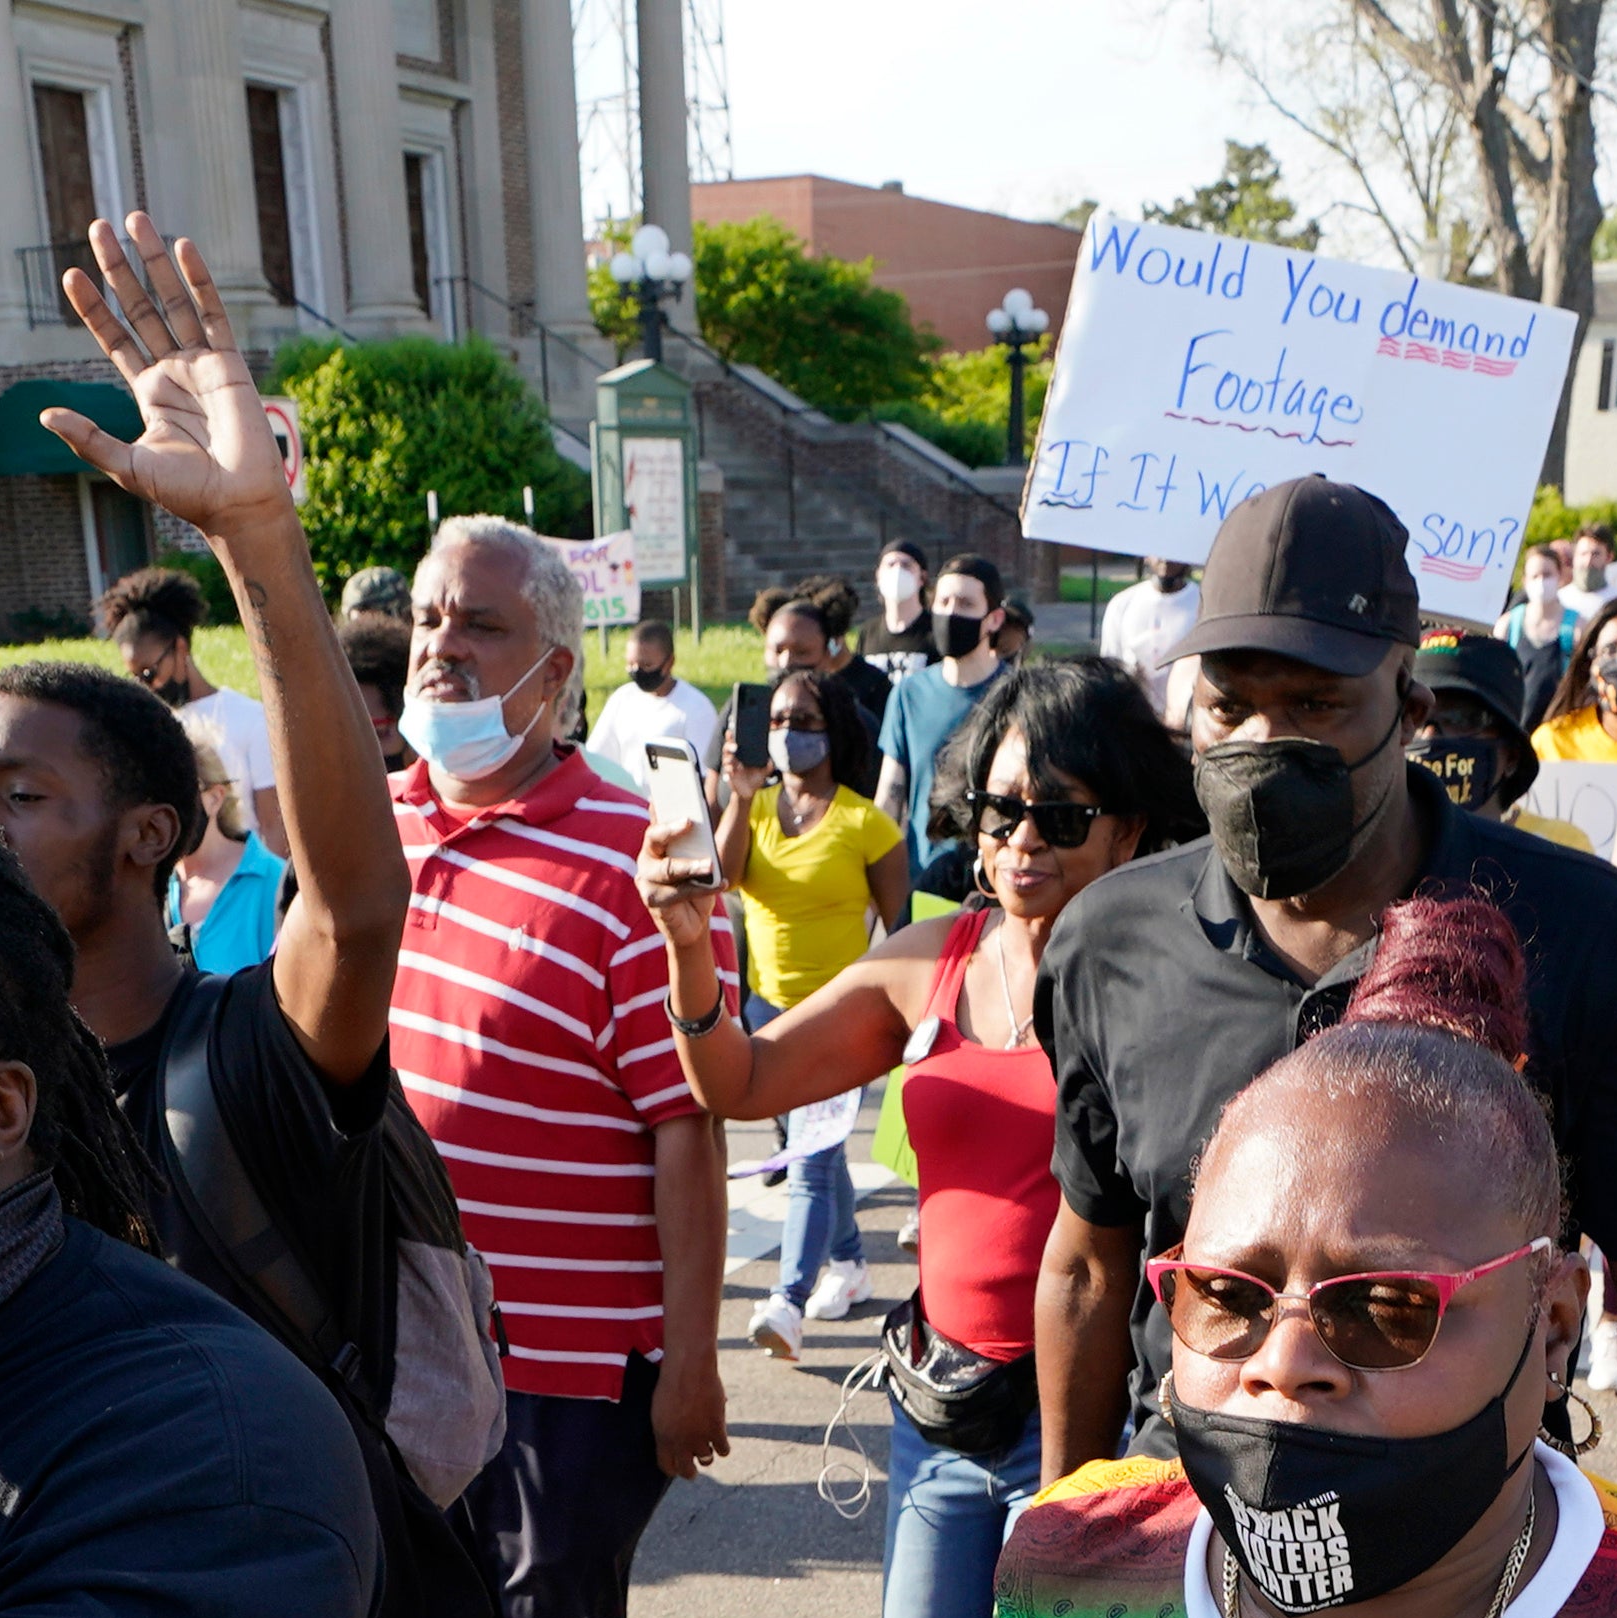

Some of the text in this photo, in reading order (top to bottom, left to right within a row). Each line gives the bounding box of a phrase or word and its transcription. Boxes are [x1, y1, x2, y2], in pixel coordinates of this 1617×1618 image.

[1090, 219, 1537, 360] Would You demand
[1175, 328, 1365, 446] Footage
[1042, 440, 1110, 505] If
[1116, 452, 1177, 512] It
[1235, 1520, 1351, 1575] VOTERS
[1248, 1564, 1355, 1605] MATTER
